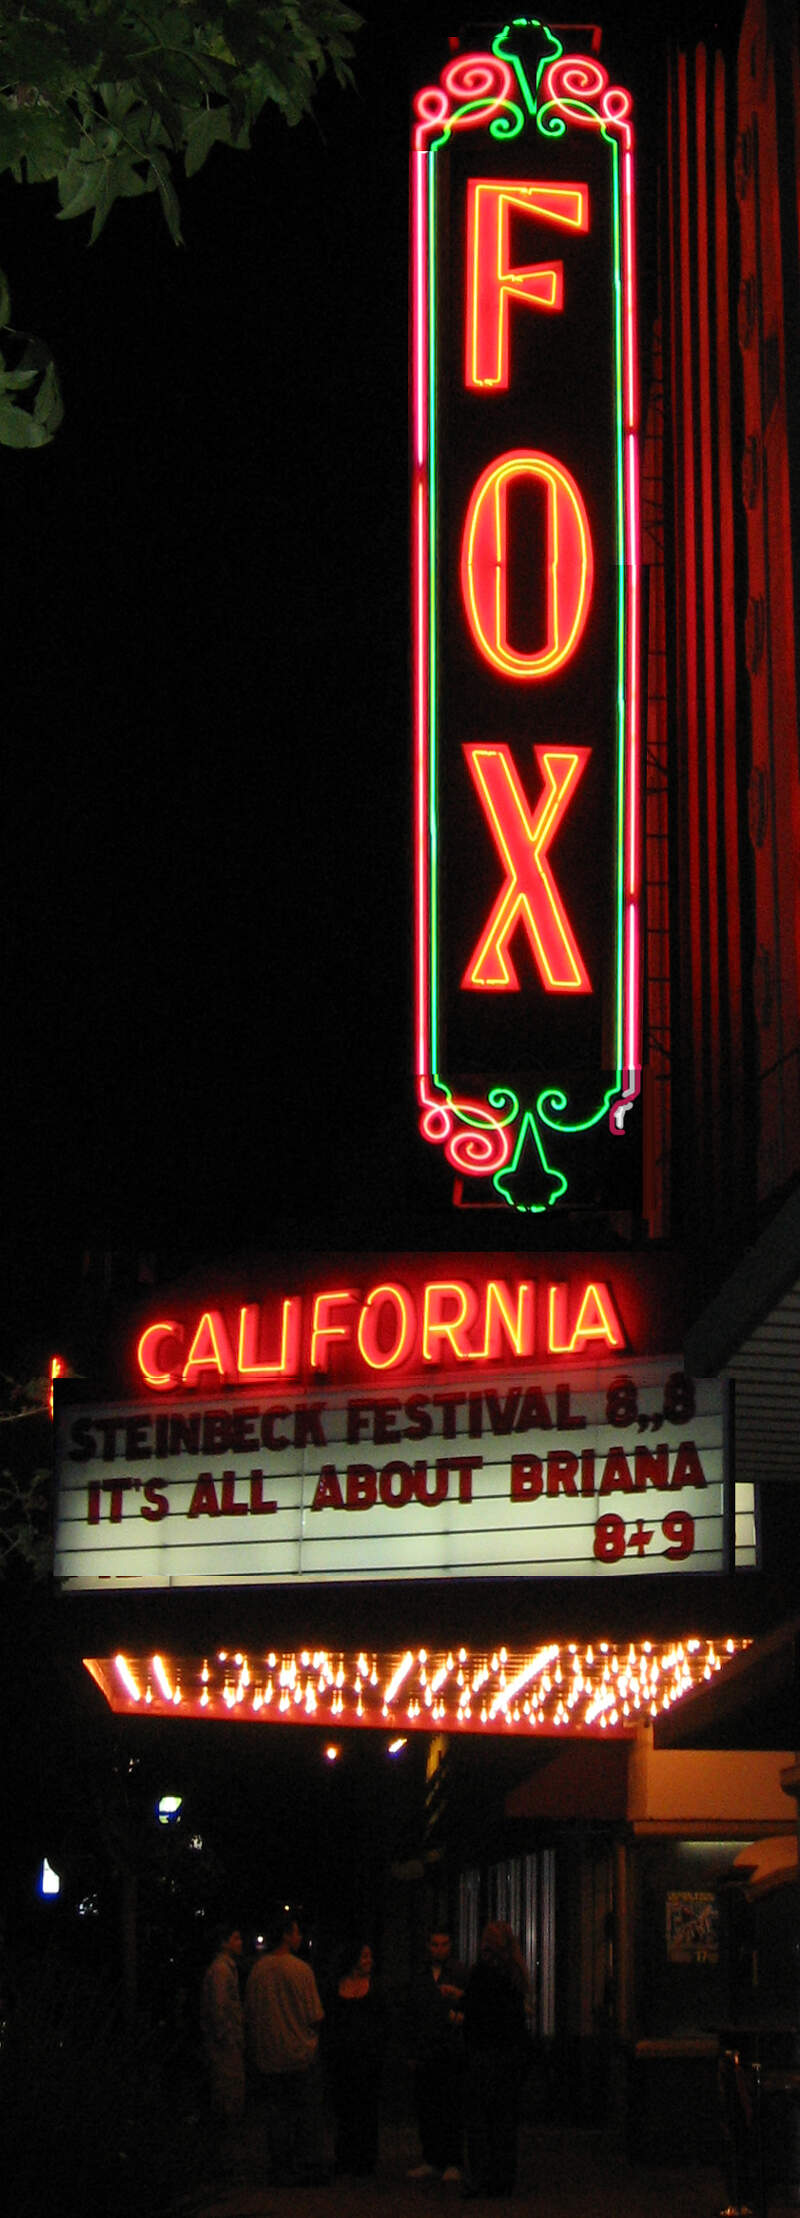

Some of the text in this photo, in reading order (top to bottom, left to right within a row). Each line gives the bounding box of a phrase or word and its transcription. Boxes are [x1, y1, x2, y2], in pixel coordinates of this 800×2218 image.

[462, 178, 593, 993] FOX
[138, 1280, 625, 1391] CALIFORNIA
[70, 1405, 327, 1462] STEINBECK
[346, 1383, 587, 1446] FESTIVAL
[87, 1441, 707, 1525] IT'S ALL ABOUT BRIANA
[593, 1511, 695, 1563] 8+9
